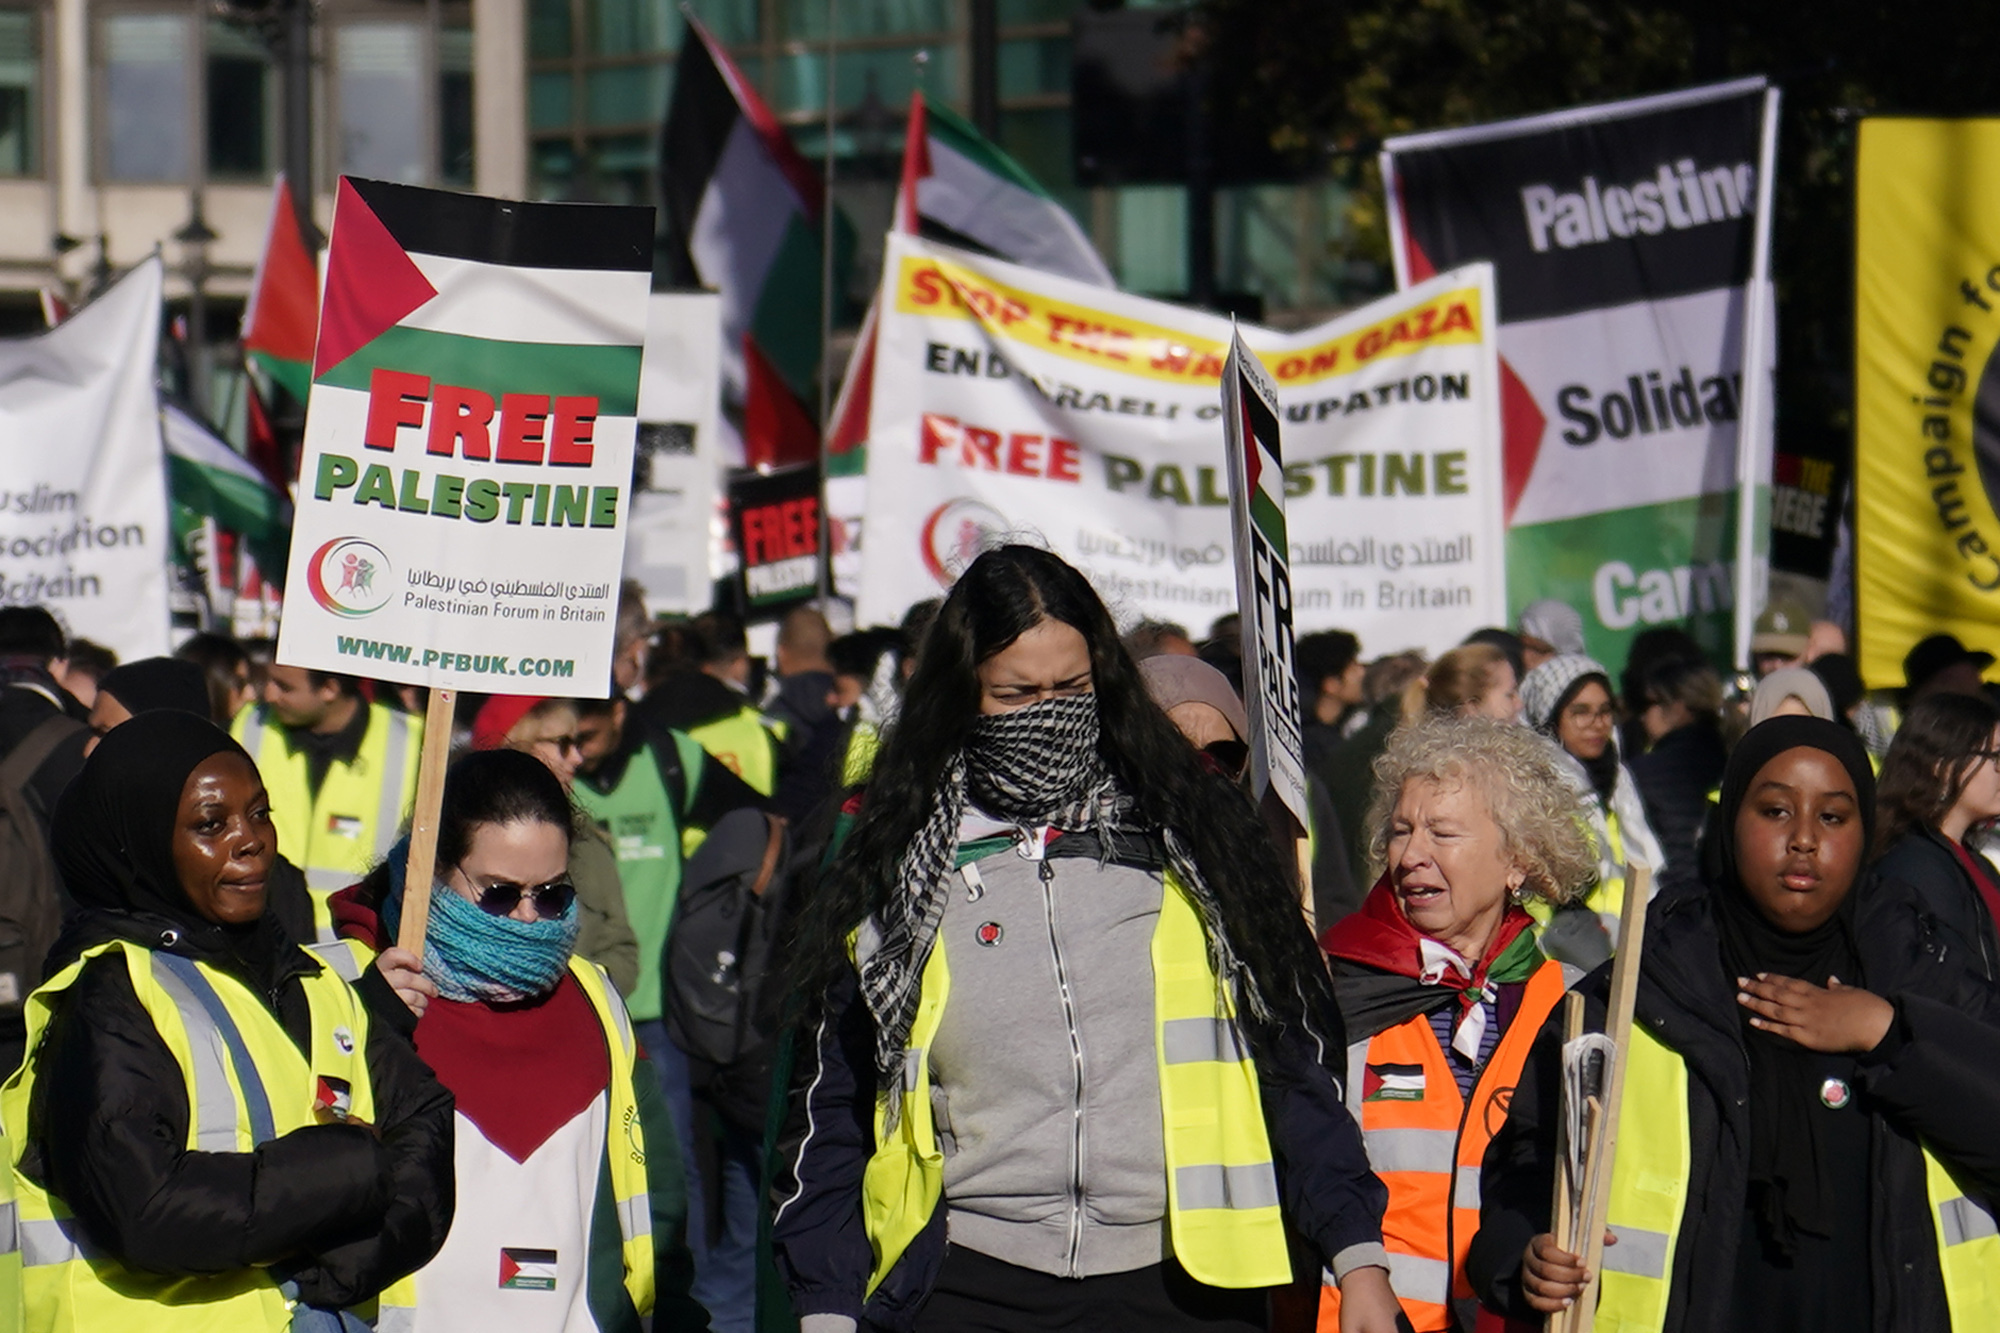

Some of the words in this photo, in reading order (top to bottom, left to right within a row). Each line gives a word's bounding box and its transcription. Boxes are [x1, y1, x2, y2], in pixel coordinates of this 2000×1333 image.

[1276, 349, 1340, 380] ON
[1354, 302, 1475, 362] GAZA
[364, 368, 599, 468] FREE
[1195, 373, 1470, 421] OUPATION
[917, 412, 1082, 484] FREE
[1102, 450, 1469, 507] PALSTINE
[314, 453, 619, 529] PALESTINE
[1771, 484, 1829, 540] IEGE
[403, 591, 489, 617] Palestinian
[493, 601, 539, 620] Forum
[543, 603, 555, 621] in
[560, 605, 606, 623] Britain
[1341, 577, 1365, 608] in
[1377, 577, 1473, 610] Britain
[336, 634, 575, 678] WWW.PFBUK.COM
